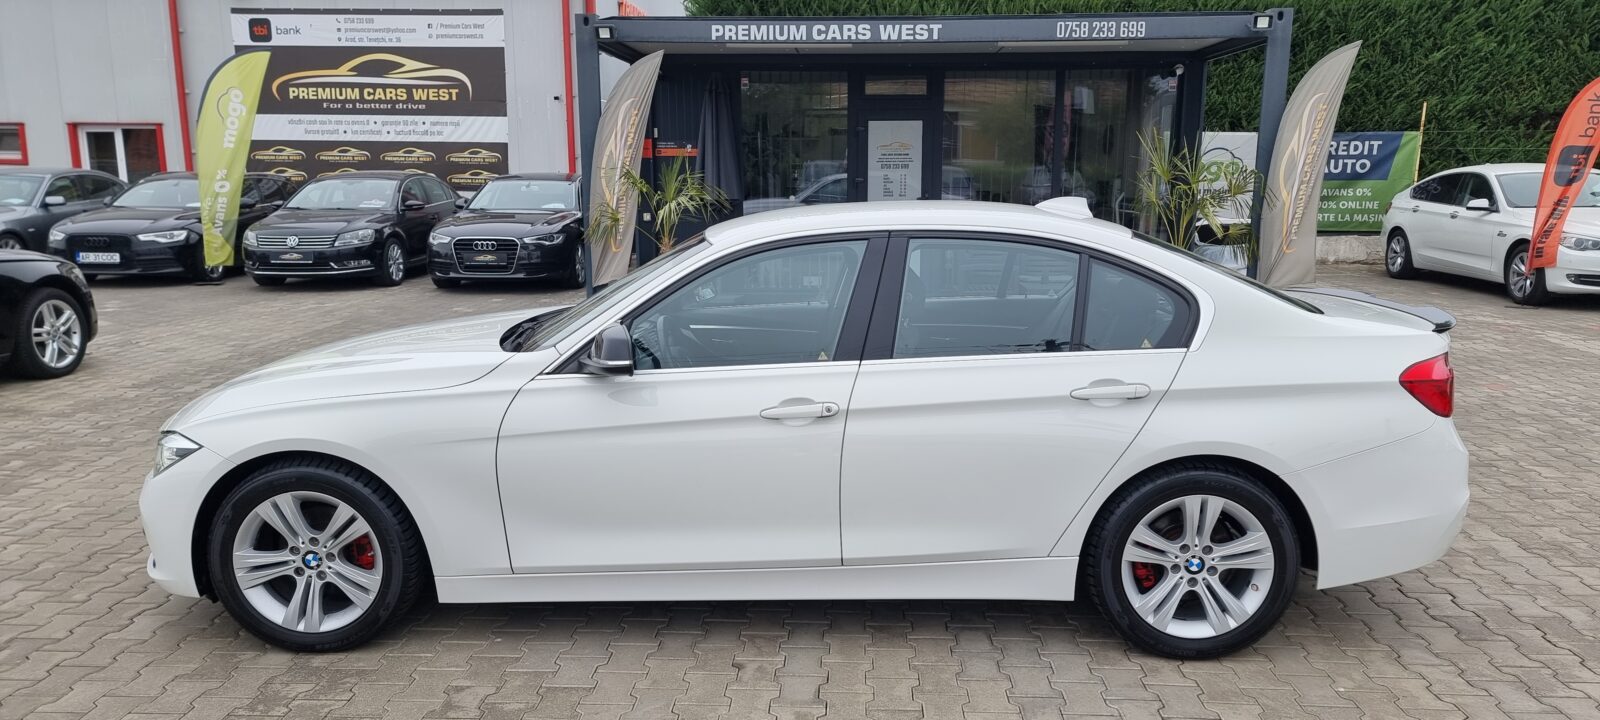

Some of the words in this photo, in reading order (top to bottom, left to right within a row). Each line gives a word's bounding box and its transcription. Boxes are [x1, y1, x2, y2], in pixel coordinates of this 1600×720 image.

[253, 25, 268, 36] tbi
[275, 25, 302, 35] bank
[711, 24, 807, 41] PREMIUM
[812, 24, 872, 41] CARS
[879, 24, 943, 41] WEST
[1056, 21, 1089, 38] 0758
[1092, 21, 1116, 38] 233
[1120, 21, 1146, 38] 699
[289, 87, 359, 100] PREMIUM
[363, 88, 407, 101] CARS
[412, 89, 459, 101] WEST
[395, 102, 426, 110] drive
[224, 88, 246, 149] mogo
[1329, 140, 1382, 155] REDIT
[214, 169, 231, 193] 0%
[1356, 188, 1372, 196] 0%
[1290, 183, 1308, 240] PREMIUM
[1339, 201, 1379, 209] ONLINE
[1317, 214, 1335, 222] RTE
[1338, 214, 1351, 222] LA
